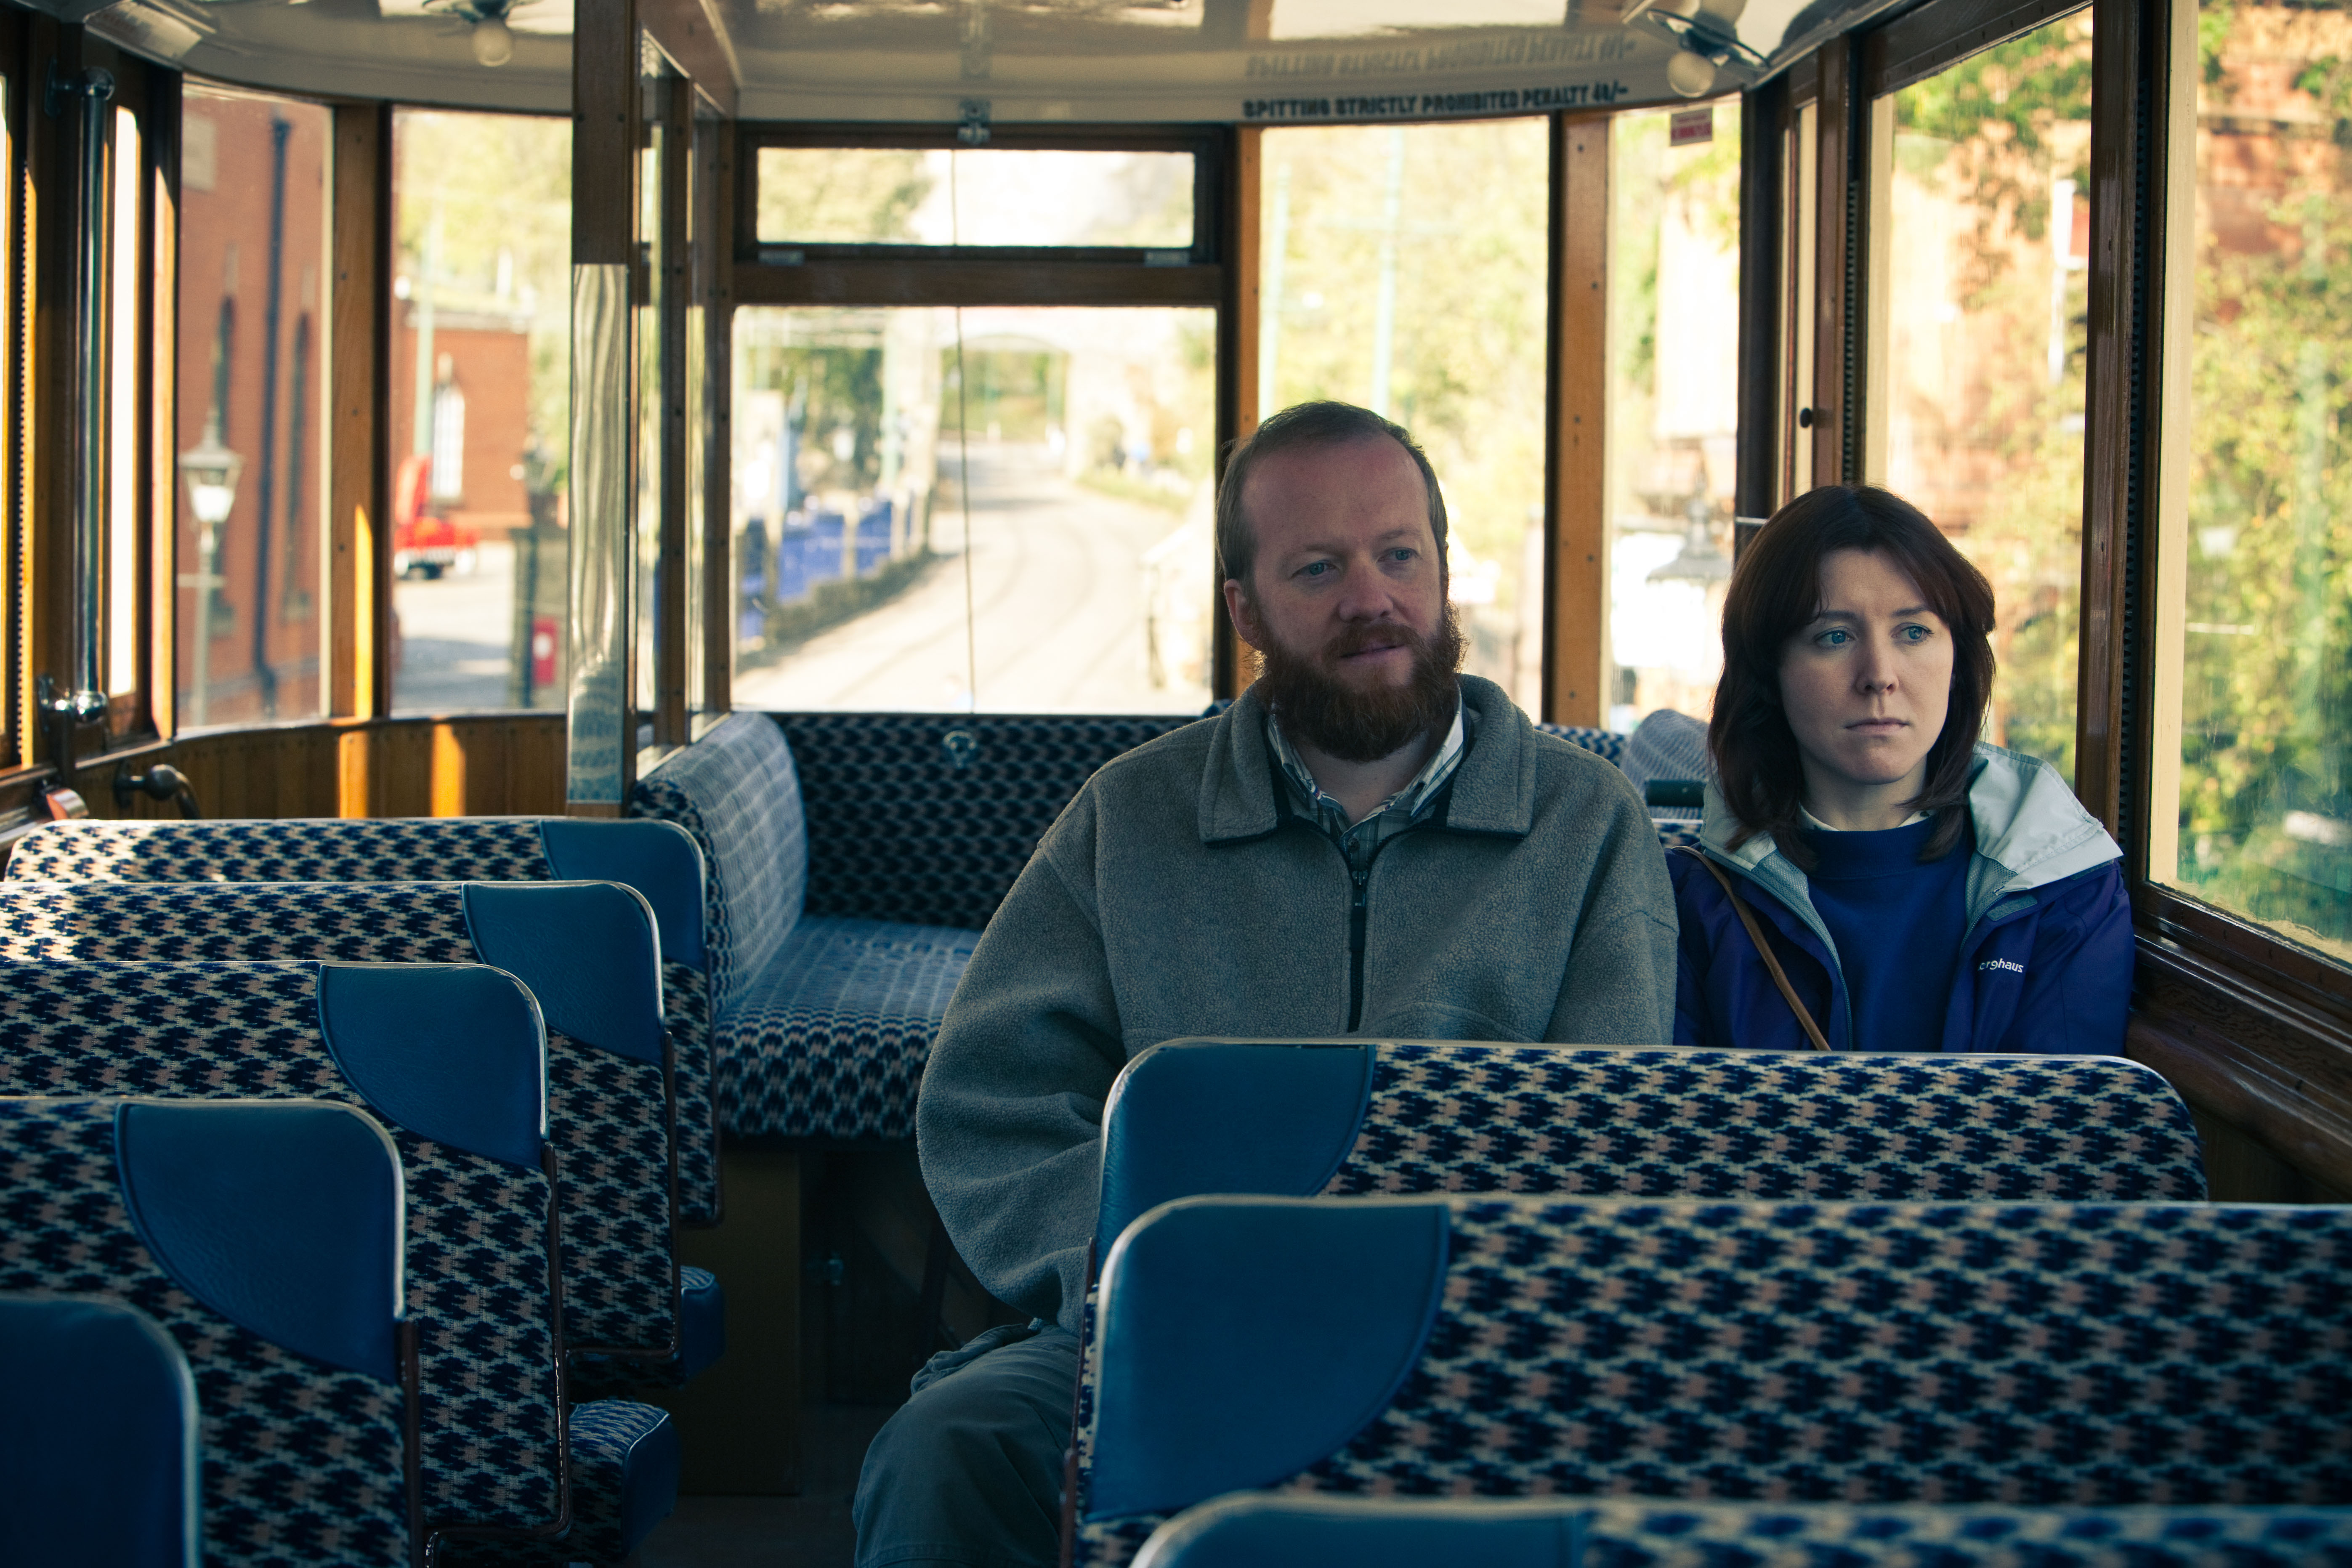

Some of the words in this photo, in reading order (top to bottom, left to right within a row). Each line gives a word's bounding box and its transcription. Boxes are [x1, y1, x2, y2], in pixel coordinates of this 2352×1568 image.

[1244, 99, 1330, 117] SPITTING
[1335, 95, 1417, 114] STRICTLY
[1422, 90, 1517, 112] PROHIBITED
[1522, 85, 1588, 106] PENALTY
[1977, 958, 2024, 973] erghaus
